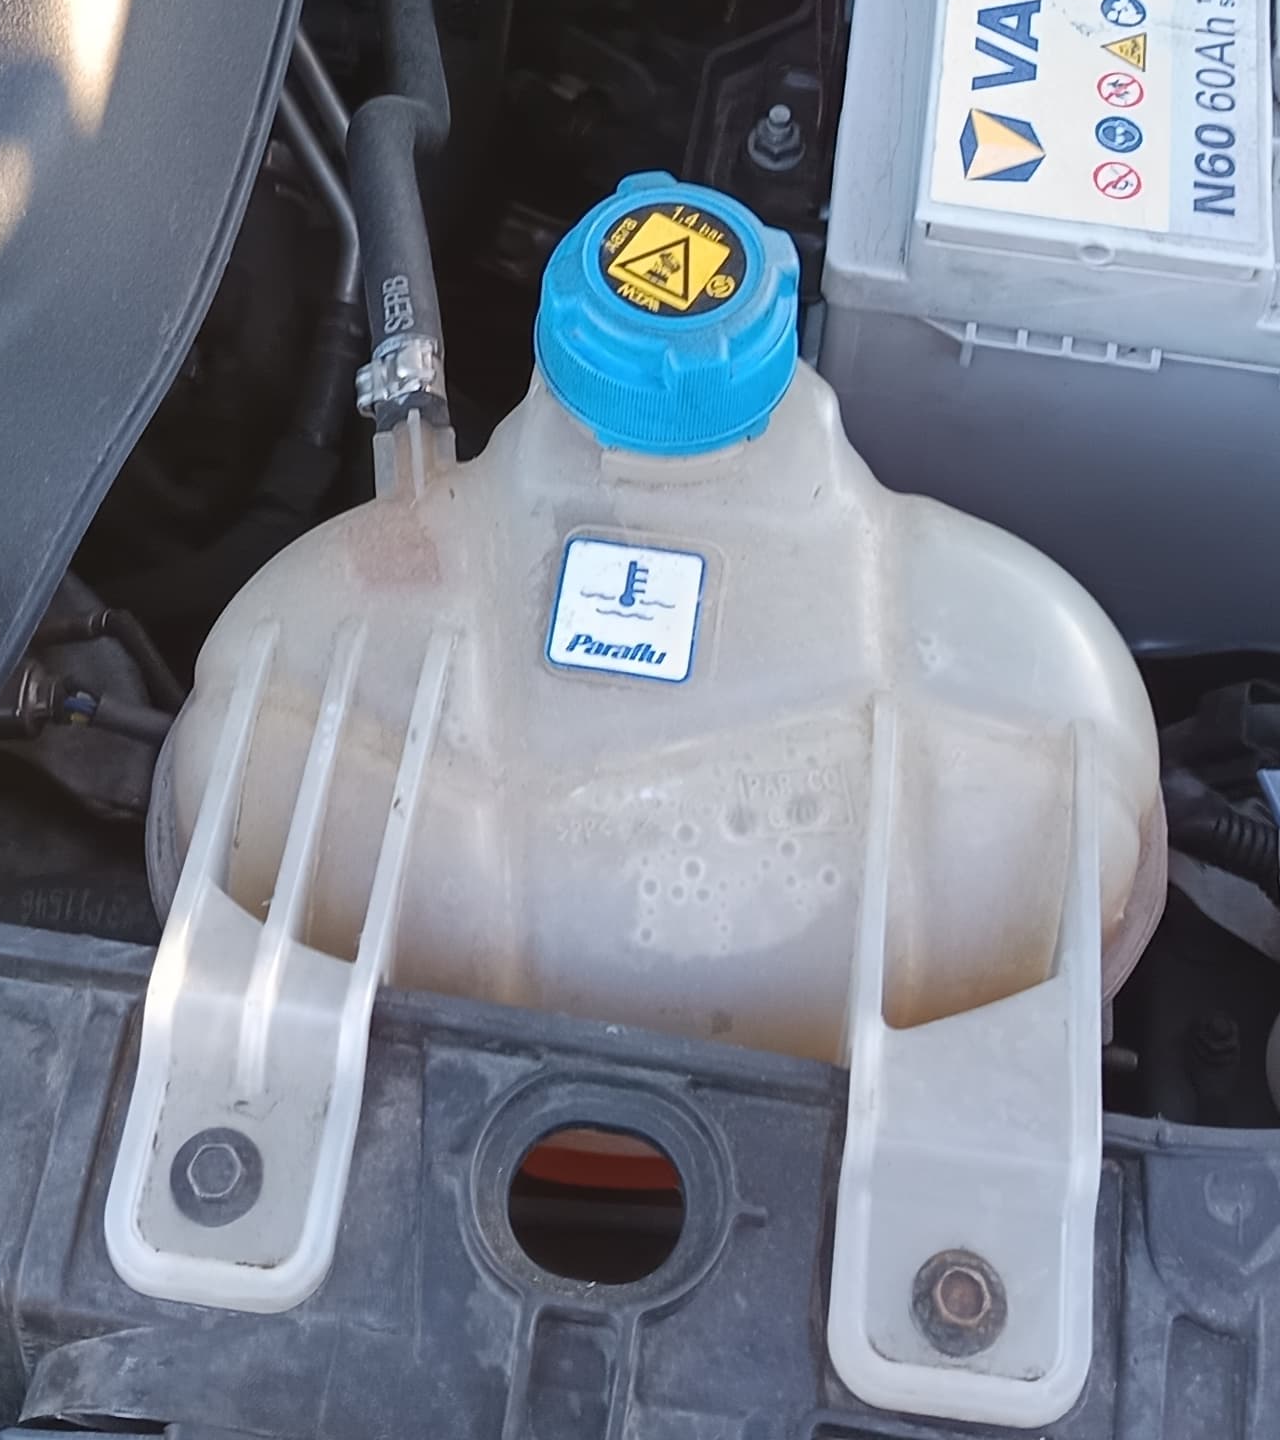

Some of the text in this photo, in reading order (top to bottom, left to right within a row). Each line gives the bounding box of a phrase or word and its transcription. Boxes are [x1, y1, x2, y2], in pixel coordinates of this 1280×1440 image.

[1193, 16, 1236, 217] N60 60Ah
[699, 221, 726, 242] bar
[566, 631, 667, 667] Paraflu
